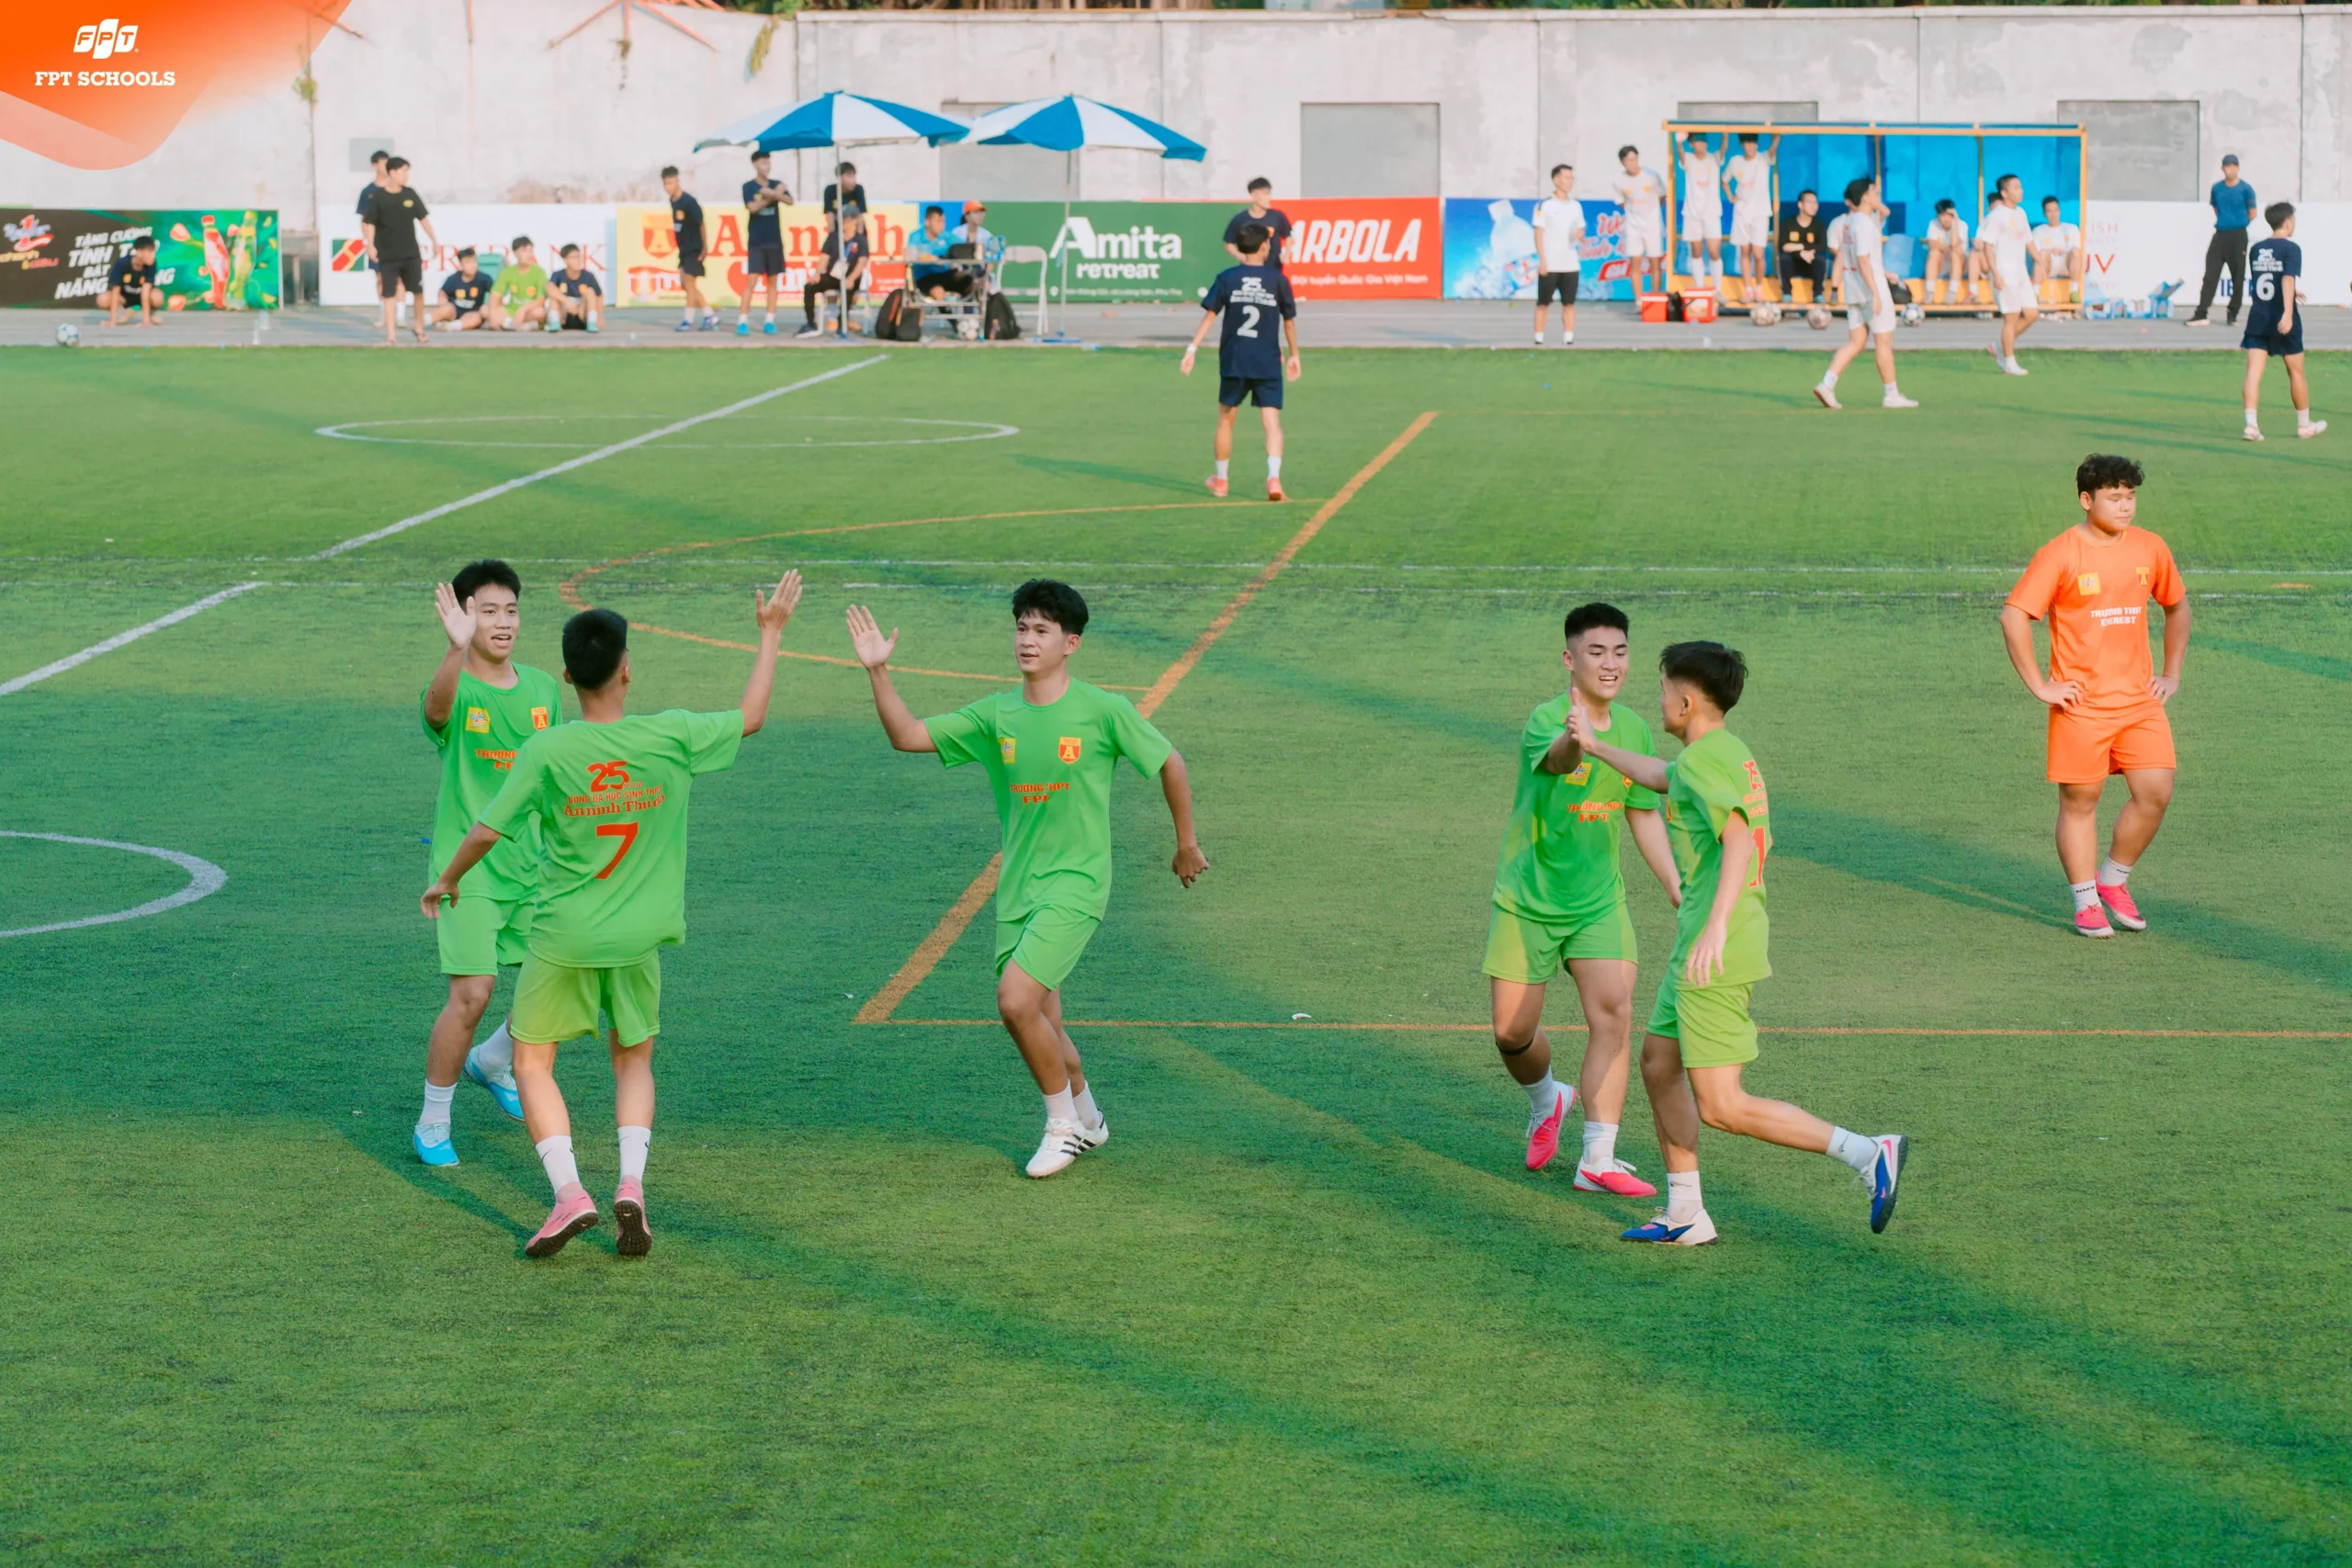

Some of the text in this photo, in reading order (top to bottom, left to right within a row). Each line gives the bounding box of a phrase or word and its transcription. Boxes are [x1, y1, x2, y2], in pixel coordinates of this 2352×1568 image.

[1049, 217, 1182, 259] Amita
[1076, 262, 1160, 279] retreat
[2256, 272, 2276, 301] 6
[1237, 305, 1261, 339] 2
[586, 761, 631, 793] 25
[624, 789, 644, 800] SINH
[1579, 812, 1609, 823] FPT
[594, 820, 639, 880] 7
